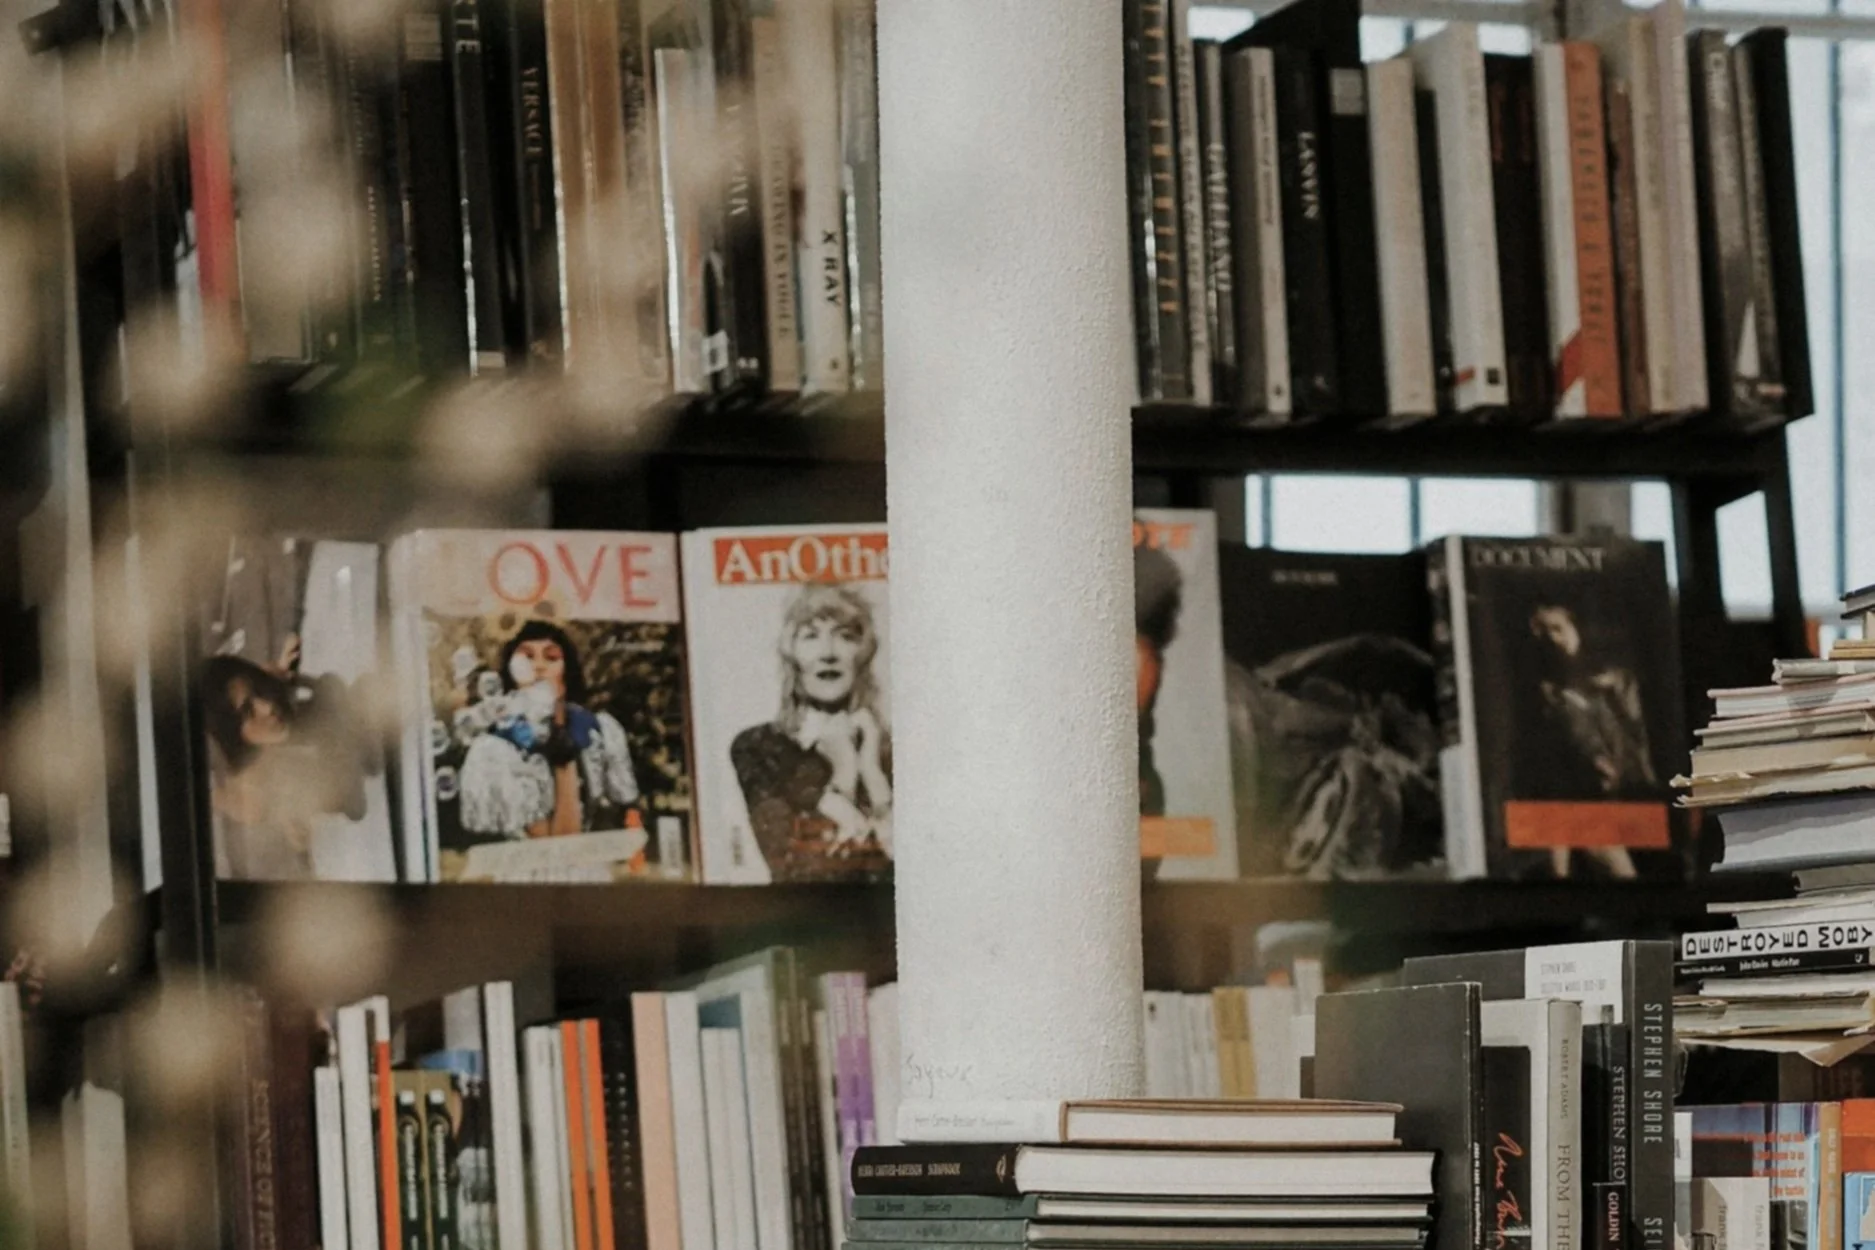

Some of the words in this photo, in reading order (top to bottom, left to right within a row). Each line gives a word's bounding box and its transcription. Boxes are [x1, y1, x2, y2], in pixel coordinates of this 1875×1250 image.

[521, 66, 543, 155] VERSACE
[1298, 131, 1320, 219] LANVIN
[821, 229, 838, 246] X
[822, 257, 842, 308] RAY
[487, 540, 659, 608] OVE
[1471, 546, 1607, 572] DOCUMENT
[1686, 928, 1809, 956] DESTROYED
[1818, 925, 1873, 949] MOBY
[1561, 1039, 1569, 1085] ROBERT
[1643, 1003, 1663, 1078] STEPHEN
[254, 1079, 273, 1176] SCIENCE
[1560, 1087, 1569, 1120] ADAMS
[1612, 1066, 1626, 1140] STEPHEN
[1643, 1090, 1663, 1143] SHORE
[1557, 1144, 1572, 1201] FROM
[1612, 1145, 1626, 1186] SHO
[1607, 1191, 1620, 1243] GOLDIN
[1717, 1204, 1729, 1242] frank
[1755, 1204, 1766, 1241] frank
